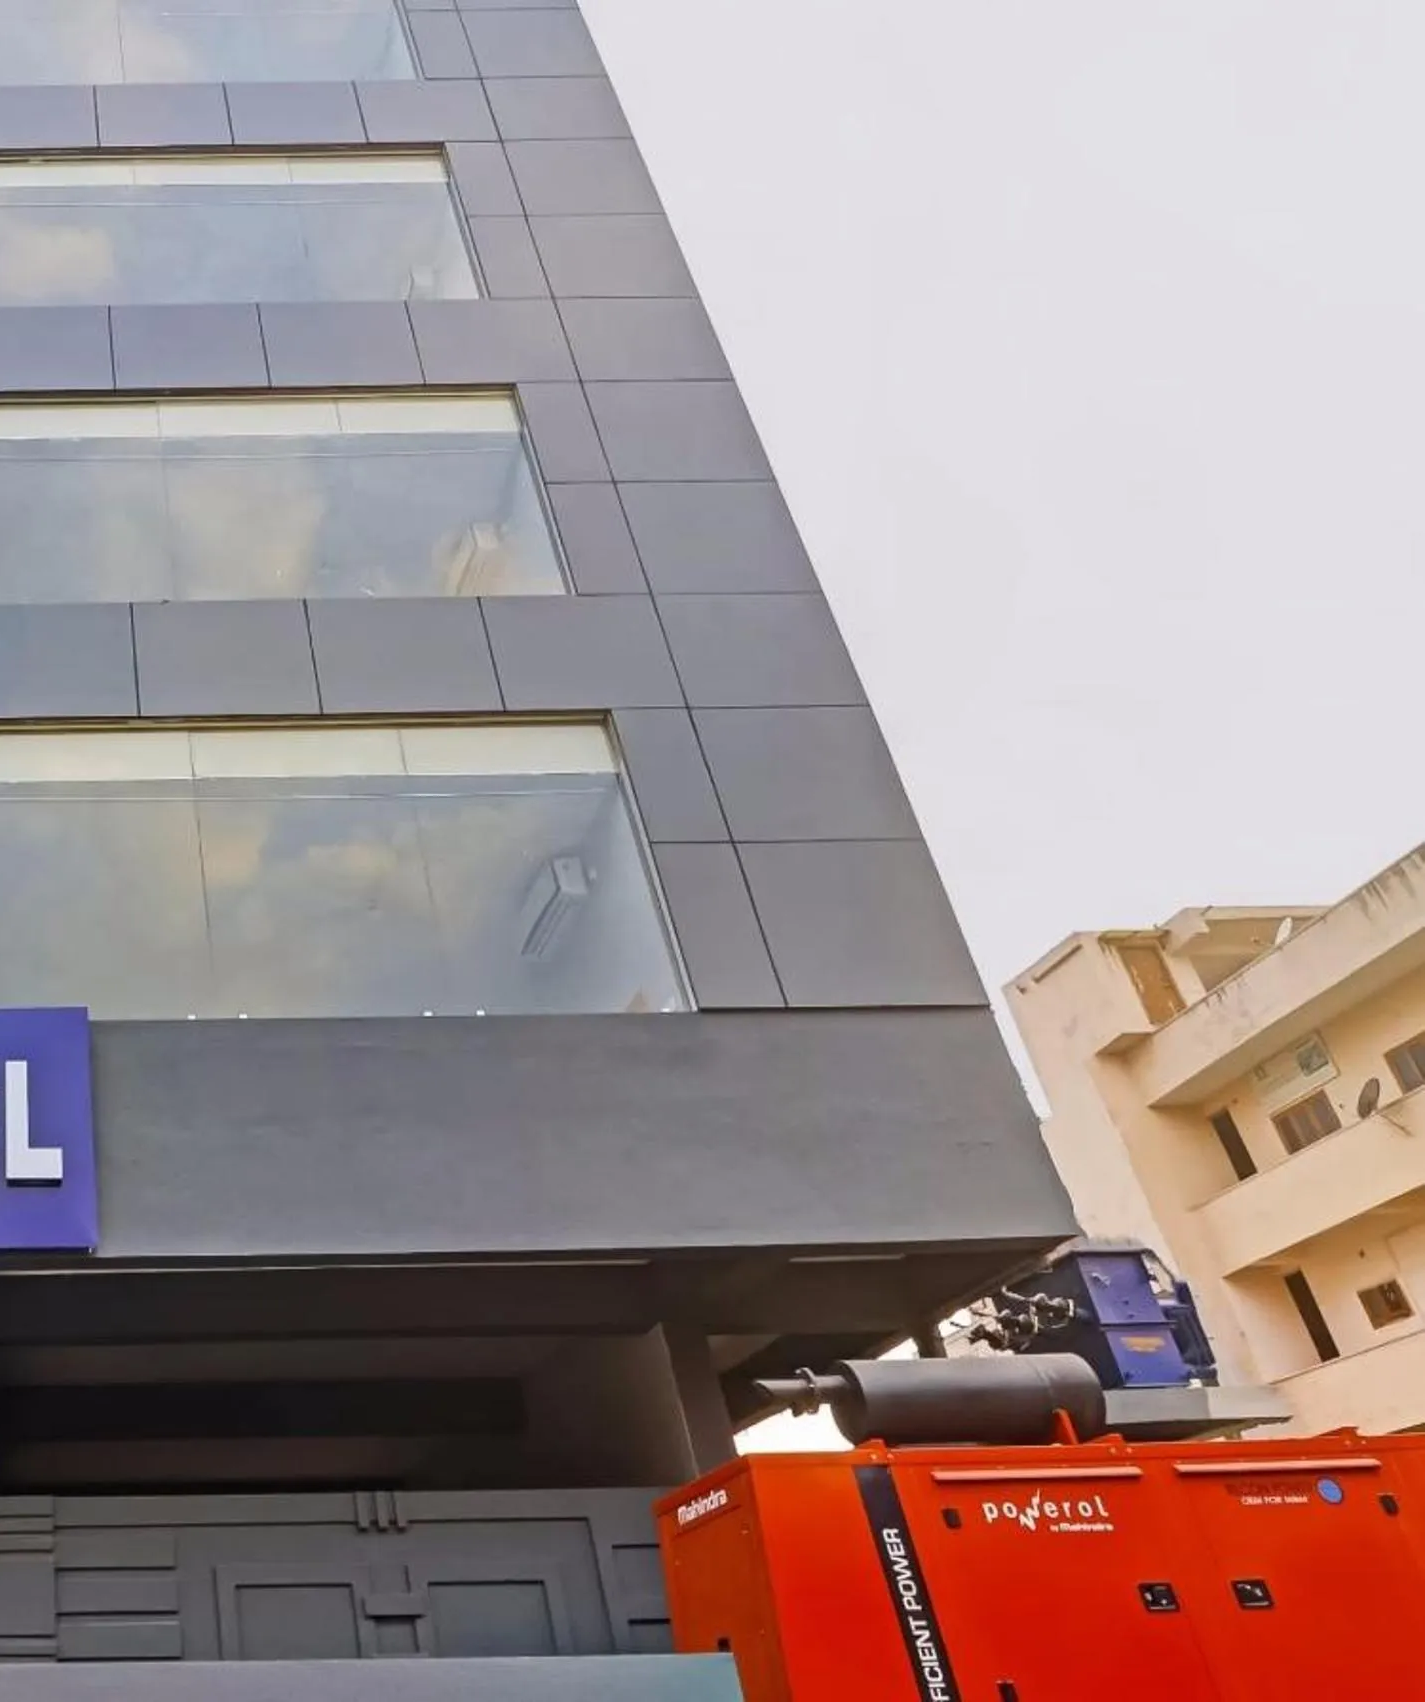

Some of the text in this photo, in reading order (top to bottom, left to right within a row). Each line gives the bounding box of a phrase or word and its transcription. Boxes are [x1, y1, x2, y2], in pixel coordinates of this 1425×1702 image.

[677, 1488, 728, 1526] Mahindra
[882, 1527, 951, 1702] FICIENT POWER
